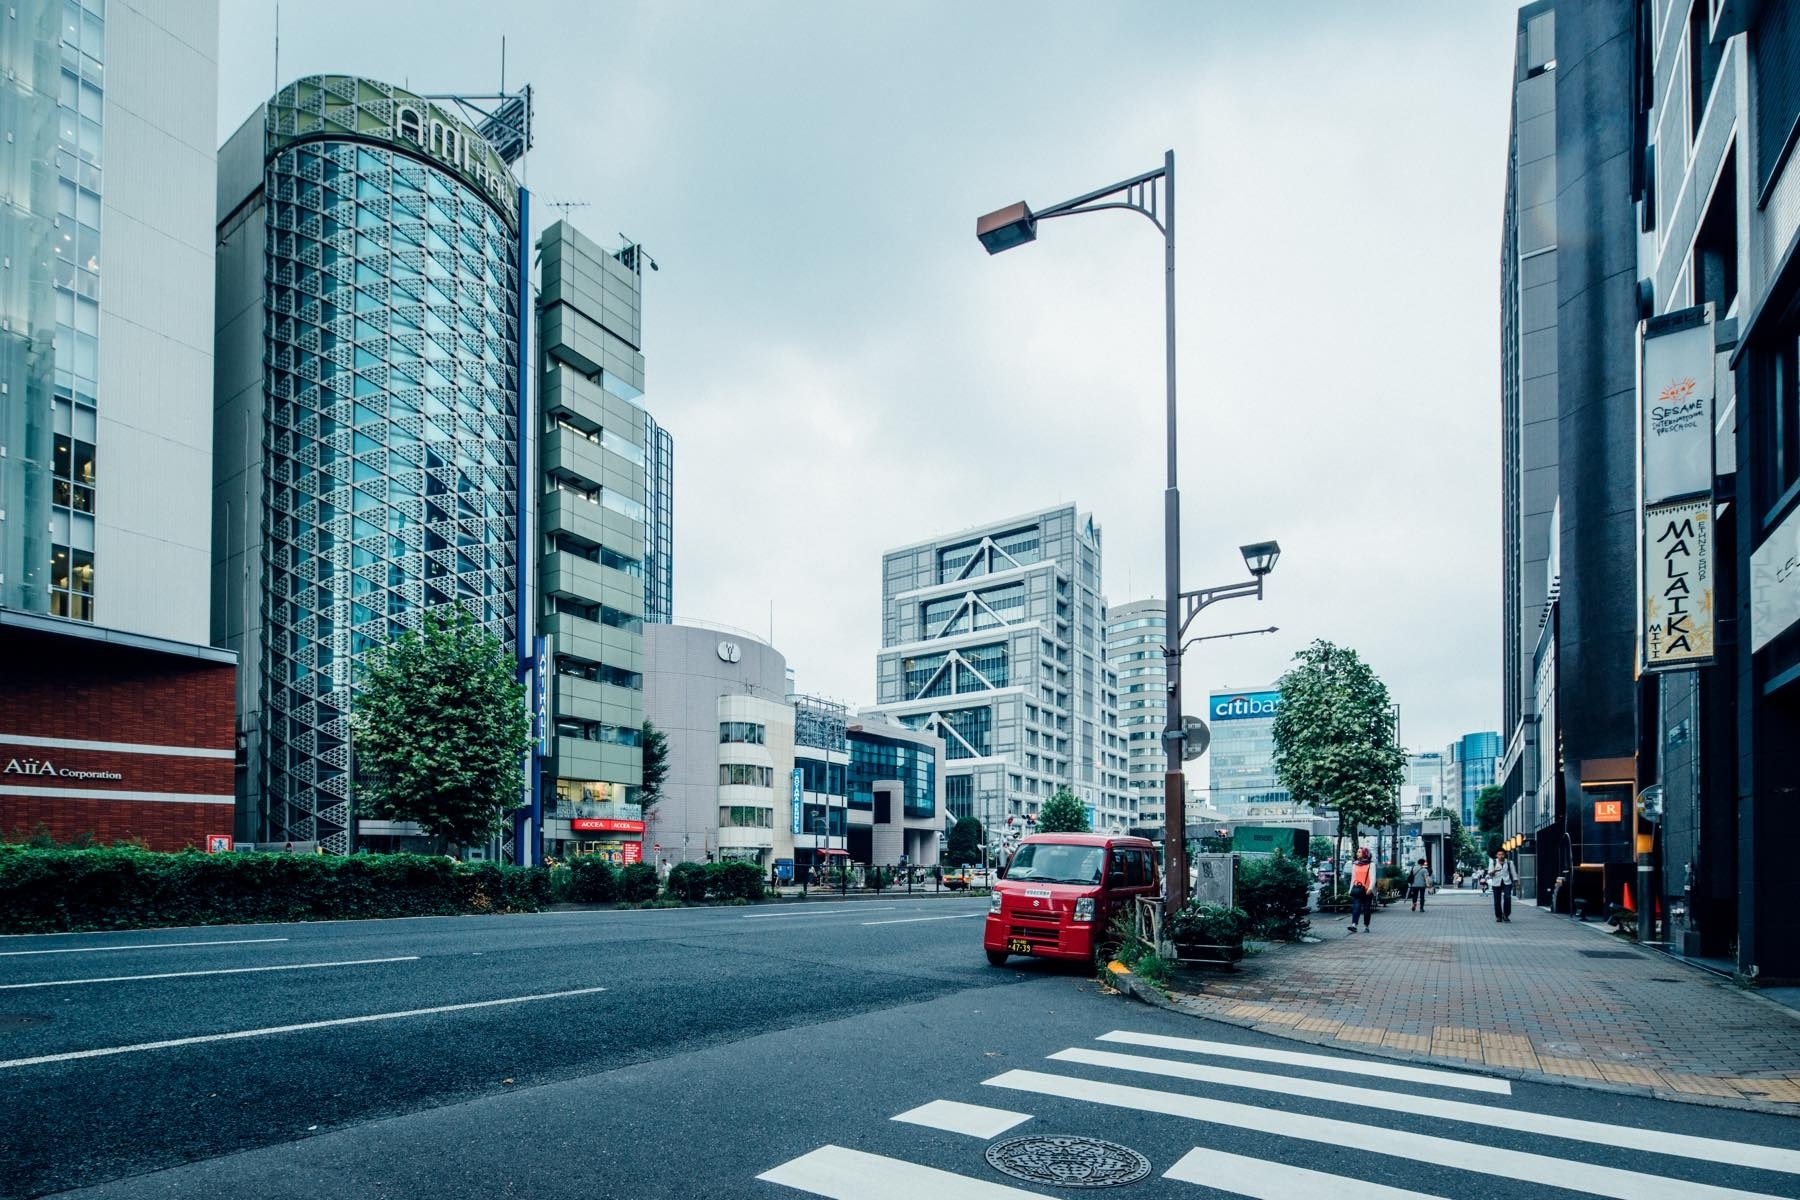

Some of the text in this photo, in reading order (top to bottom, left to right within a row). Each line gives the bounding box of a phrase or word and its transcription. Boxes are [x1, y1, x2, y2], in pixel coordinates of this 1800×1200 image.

[397, 105, 470, 171] AMI
[1651, 399, 1704, 420] SESAME
[1698, 558, 1707, 581] SHOP
[1656, 518, 1695, 654] MALAIKA
[1649, 623, 1662, 659] MITI
[1216, 697, 1280, 716] citiba
[60, 768, 122, 780] Corporation
[1597, 804, 1617, 815] LR
[1012, 944, 1031, 953] 47-39
